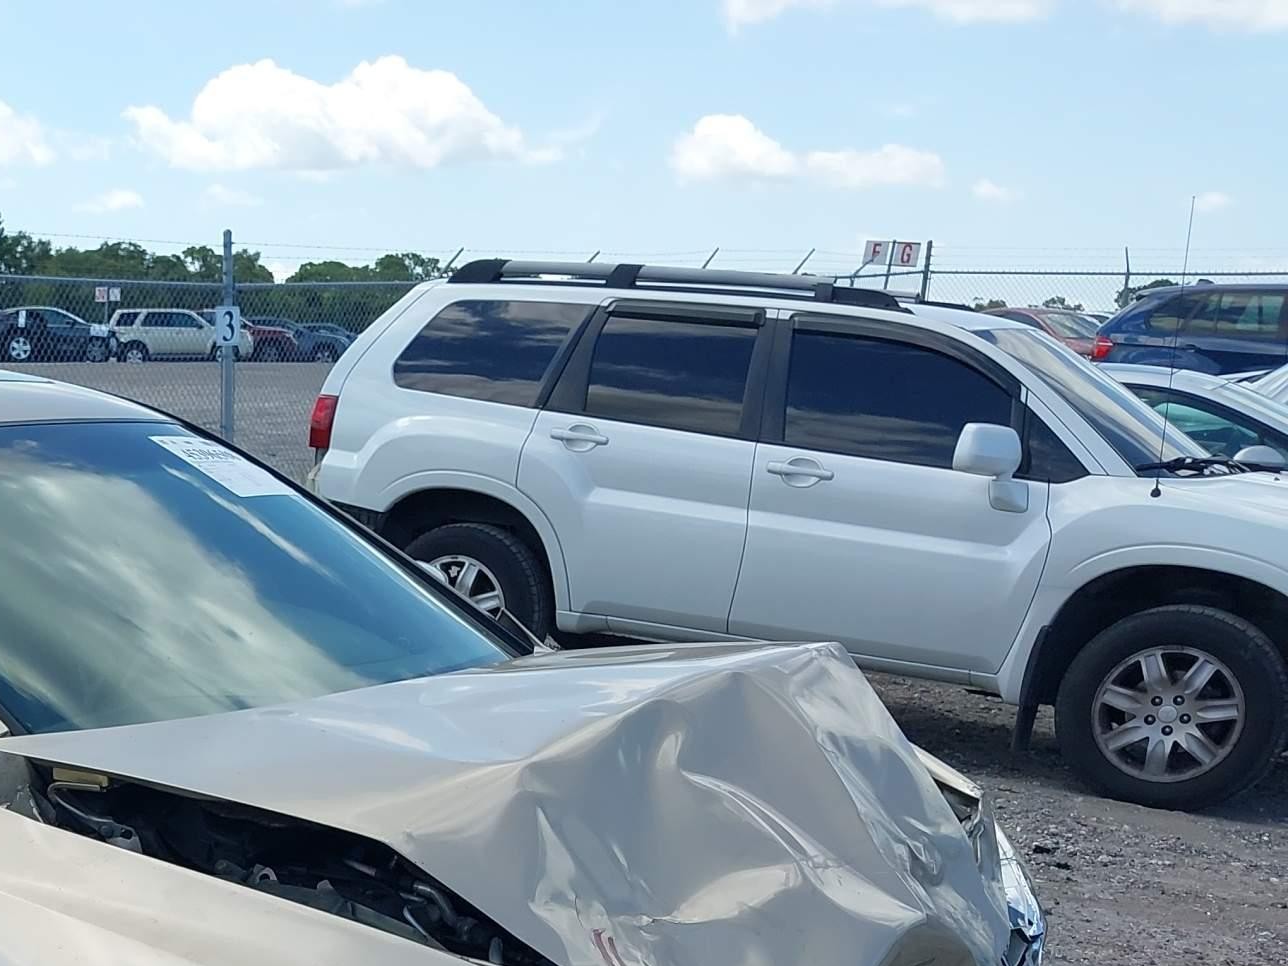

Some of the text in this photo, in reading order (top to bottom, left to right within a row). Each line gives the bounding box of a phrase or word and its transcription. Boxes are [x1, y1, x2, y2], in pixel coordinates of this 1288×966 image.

[871, 243, 882, 260] F
[900, 243, 913, 264] G
[222, 310, 235, 342] 3
